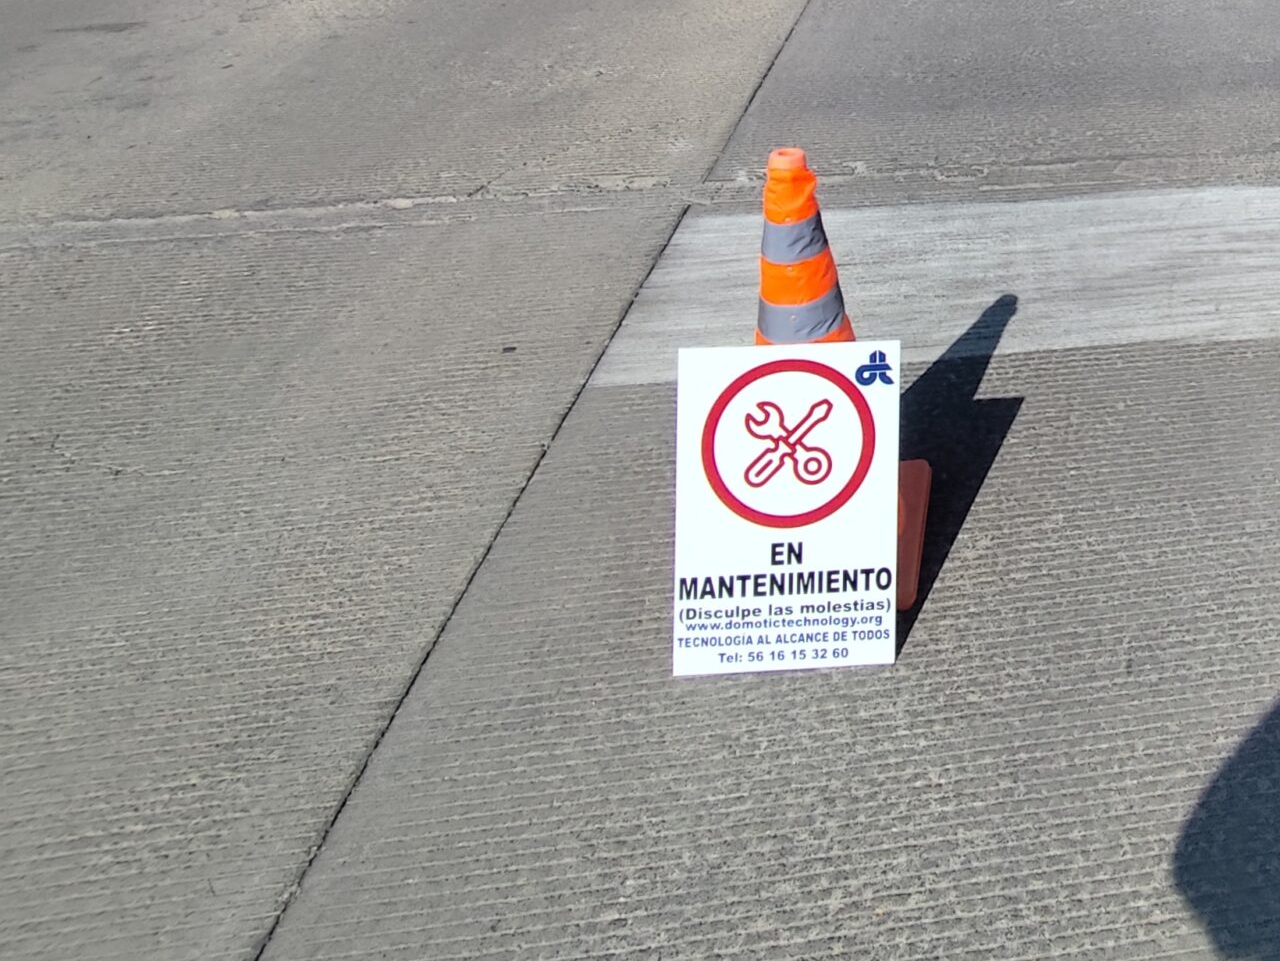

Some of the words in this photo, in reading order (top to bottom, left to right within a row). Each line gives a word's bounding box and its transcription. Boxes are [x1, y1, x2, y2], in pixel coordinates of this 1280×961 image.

[770, 541, 803, 566] EN
[679, 567, 892, 601] MANTENIMIENTO
[679, 605, 762, 624] (Disculpe
[768, 604, 794, 616] las
[800, 598, 891, 614] molestias)
[685, 615, 883, 631] www.domotictechnology.org
[757, 634, 772, 645] AL
[775, 632, 829, 644] ALCANCE
[833, 631, 848, 642] DE
[851, 629, 890, 641] TODOS
[718, 652, 742, 663] Tel:
[748, 651, 764, 662] 56
[770, 650, 785, 661] 16
[791, 649, 807, 660] 15
[812, 648, 828, 659] 32
[832, 647, 849, 658] 60
